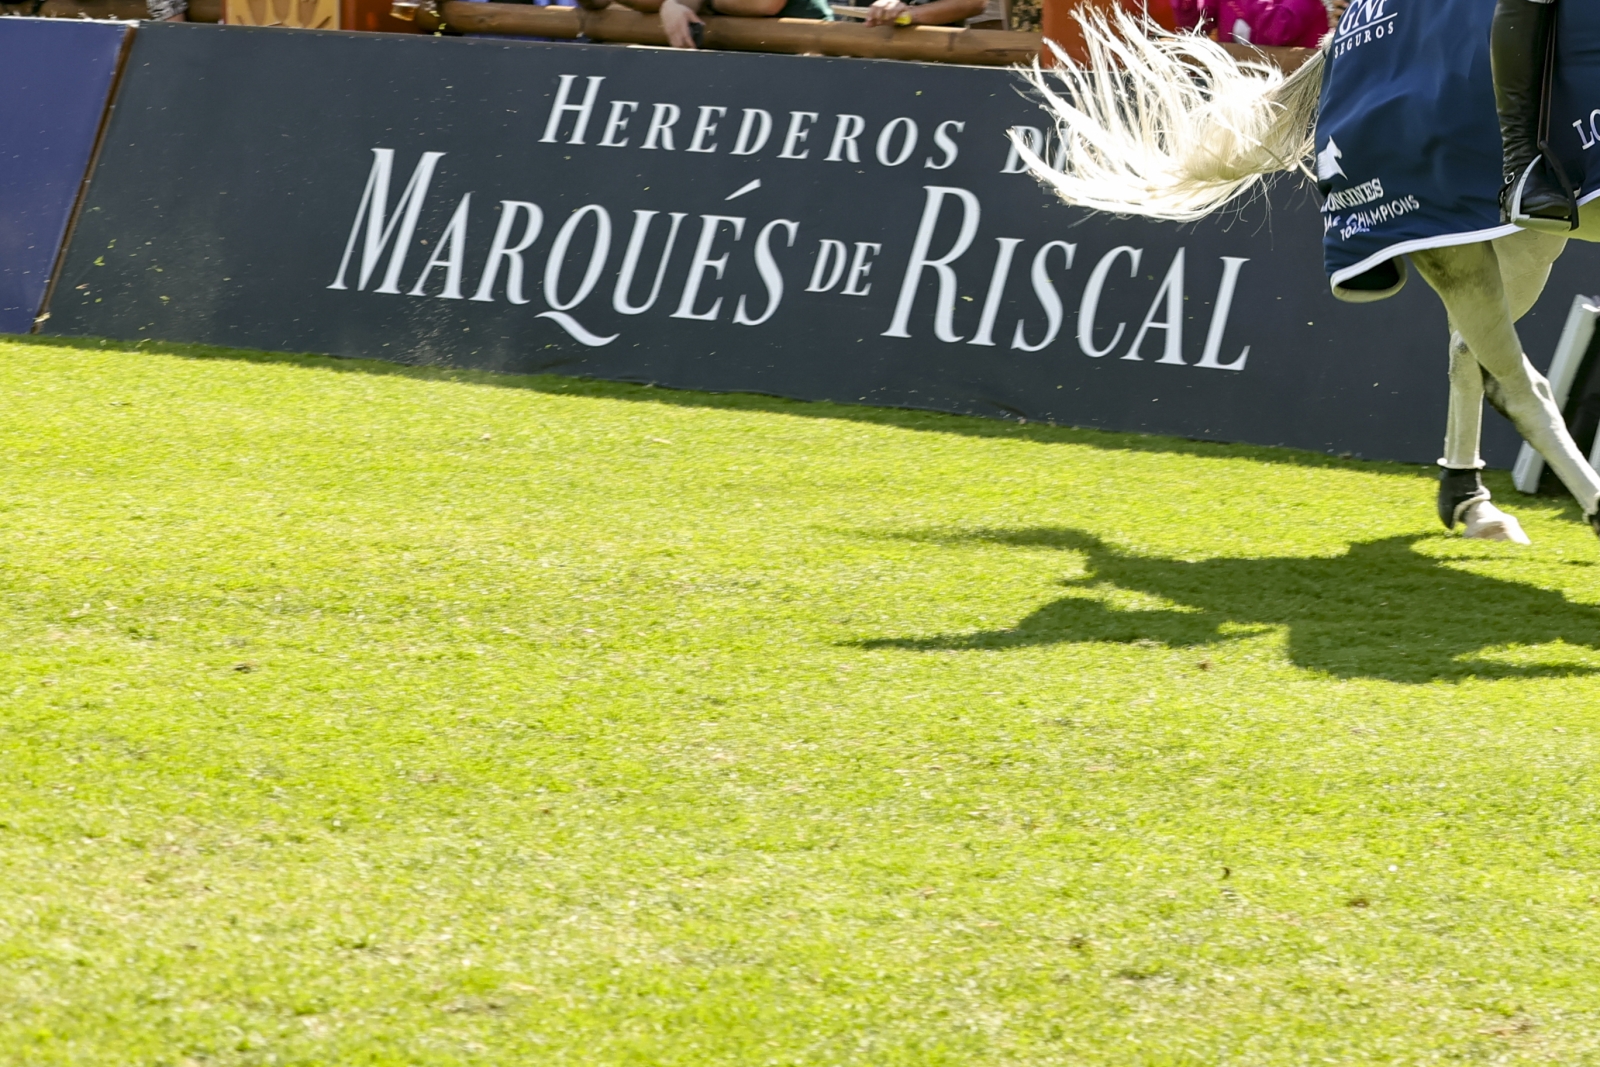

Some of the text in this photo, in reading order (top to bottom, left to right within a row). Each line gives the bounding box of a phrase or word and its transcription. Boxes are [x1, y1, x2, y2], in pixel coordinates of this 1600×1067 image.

[1334, 21, 1394, 59] SEGUROS
[538, 74, 966, 170] HEREDEROS
[326, 148, 1251, 371] MARQUÉS DE RISCAL
